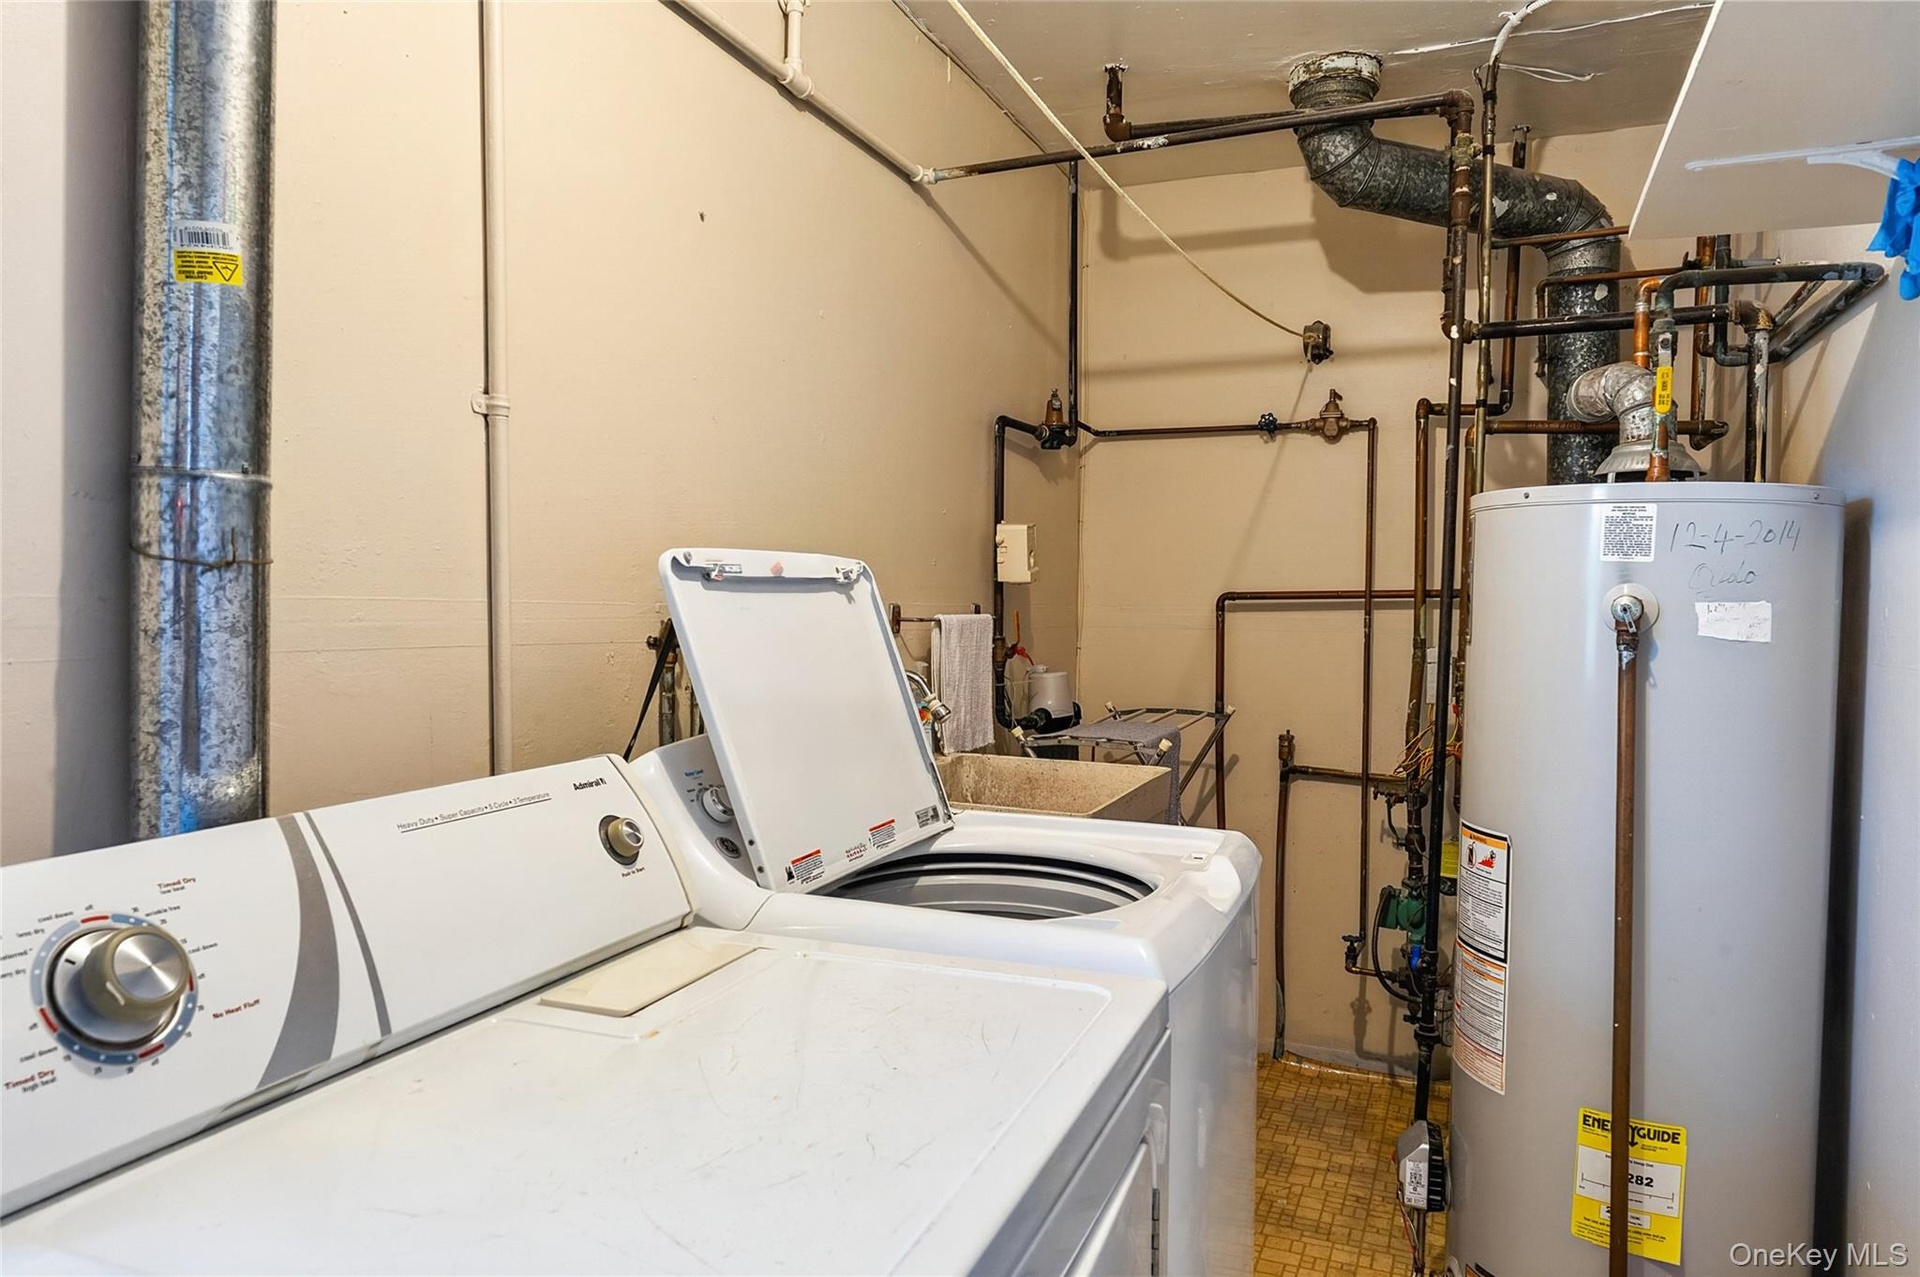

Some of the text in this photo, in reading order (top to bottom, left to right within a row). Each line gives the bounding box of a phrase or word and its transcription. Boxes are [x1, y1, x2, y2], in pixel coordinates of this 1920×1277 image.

[1670, 519, 1801, 555] 12-4-2014
[573, 778, 601, 791] Admiral
[397, 821, 418, 831] Heavy
[418, 817, 435, 827] Duty
[438, 811, 459, 822] Super
[458, 806, 485, 817] Capacity
[493, 800, 510, 810] Cycle
[517, 791, 550, 804] Temperature
[158, 877, 197, 890] Timed Dry
[145, 908, 168, 917] wrinkle
[212, 998, 261, 1020] No Heat Fluff
[4, 1069, 56, 1090] Timed Dry
[1582, 1112, 1681, 1145] ENEYGUIDE
